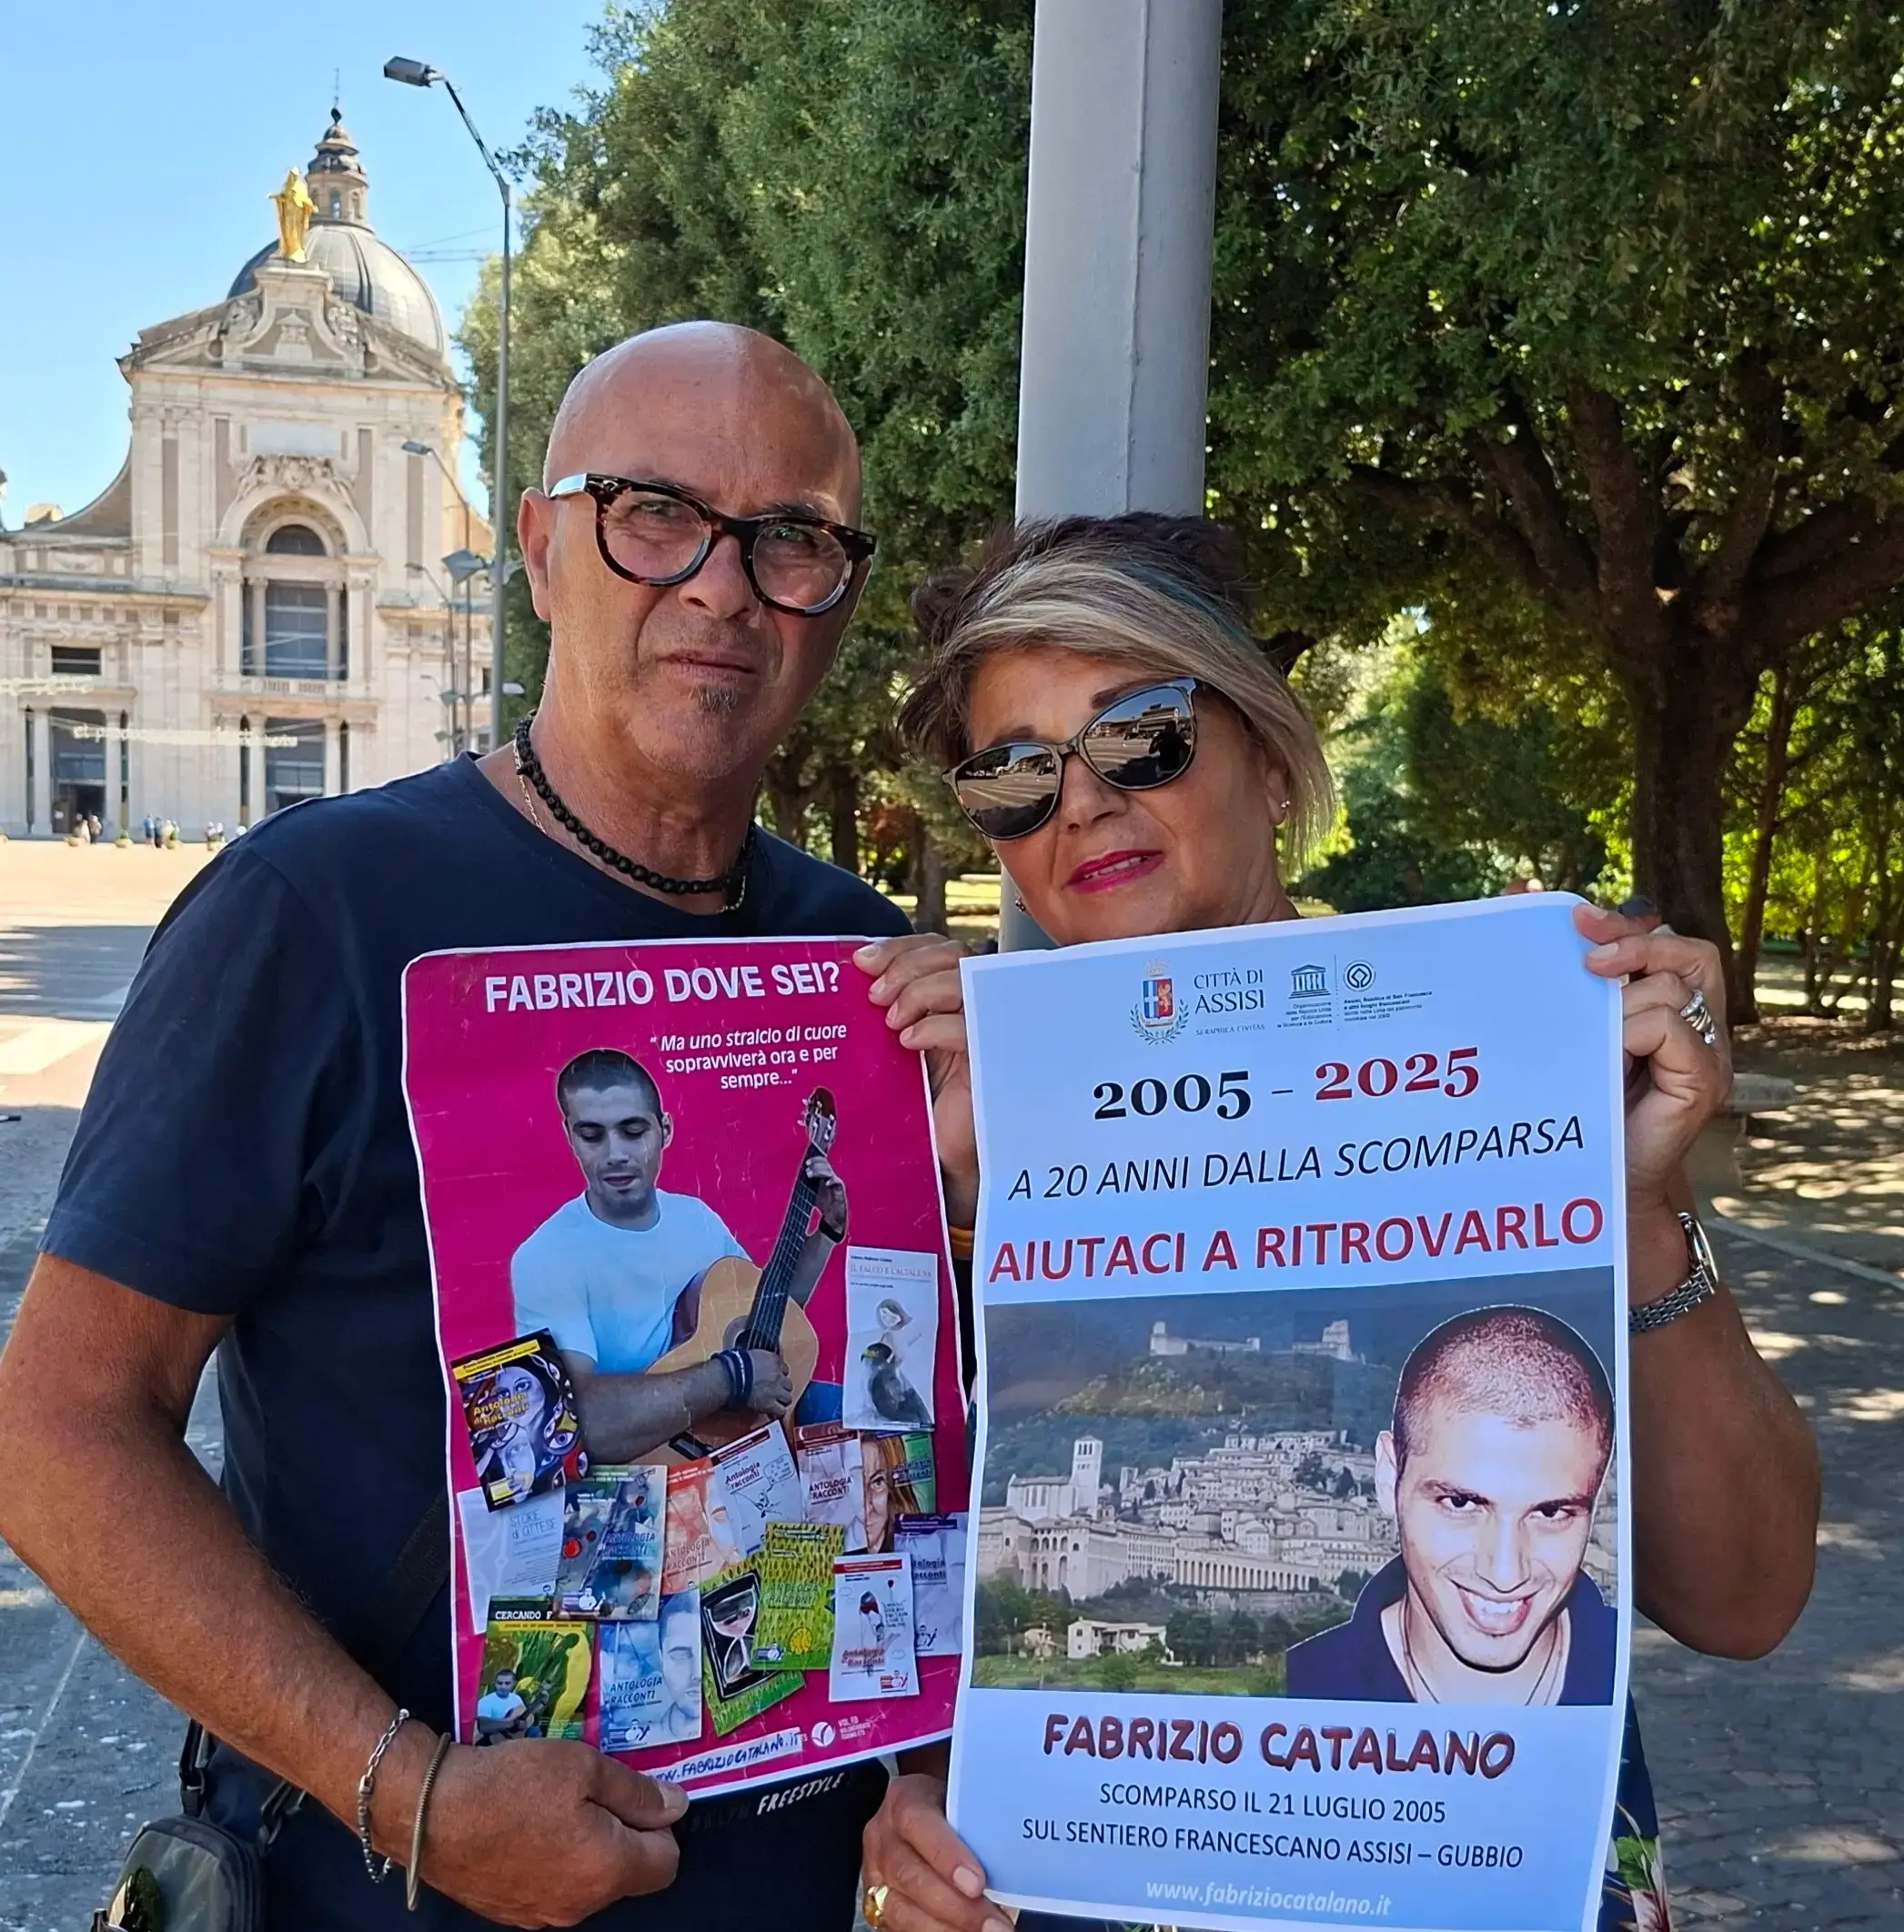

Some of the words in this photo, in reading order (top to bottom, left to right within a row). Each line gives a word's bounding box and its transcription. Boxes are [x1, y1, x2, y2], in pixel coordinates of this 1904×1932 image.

[485, 970, 654, 1012] FABRIZIO
[663, 965, 765, 1002] DOVE
[771, 961, 841, 996] SEI?
[1194, 968, 1242, 989] CITTÀ
[1247, 969, 1263, 984] DI
[1194, 990, 1264, 1014] ASSISI
[690, 1031, 721, 1049] uno
[726, 1028, 781, 1047] stralcio
[785, 1025, 801, 1043] di
[804, 1024, 847, 1041] cuore
[665, 1052, 767, 1074] sopravviverà
[771, 1049, 796, 1065] ora
[800, 1049, 810, 1062] e
[813, 1045, 839, 1065] per
[1093, 1071, 1252, 1120] 2005
[1315, 1047, 1480, 1101] 2025
[1008, 1169, 1032, 1201] A
[1043, 1164, 1088, 1198] 20
[1096, 1156, 1189, 1195] ANNI
[1204, 1146, 1321, 1187] DALLA
[1334, 1115, 1584, 1177] SCOMPARSA
[989, 1232, 1185, 1283] AIUTACI
[1202, 1230, 1238, 1272] A
[1256, 1197, 1604, 1269] RITROVARLO
[725, 1462, 761, 1484] Antologia
[730, 1469, 761, 1489] racconti
[810, 1476, 852, 1491] ANTOLOGIA
[812, 1486, 850, 1500] RACCONTI
[495, 1610, 542, 1620] CERCANDO
[610, 1675, 663, 1691] ANTOLOGIA
[610, 1690, 656, 1704] RACCONTI
[1043, 1714, 1244, 1764] FABRIZIO
[1260, 1723, 1516, 1779] CATALANO
[756, 1772, 845, 1816] FREESTYLE
[1100, 1783, 1236, 1811] SCOMPARSO
[1244, 1791, 1262, 1813] IL
[1269, 1793, 1295, 1816] 21
[1304, 1795, 1385, 1820] LUGLIO
[1393, 1799, 1446, 1823] 2005
[1023, 1818, 1060, 1841] SUL
[1066, 1821, 1168, 1848] SENTIERO
[1175, 1828, 1340, 1860] FRANCESCANO
[1346, 1839, 1412, 1865] ASSISI
[1437, 1844, 1523, 1868] GUBBIO
[1146, 1881, 1392, 1916] www.fabriziocatalano.it
